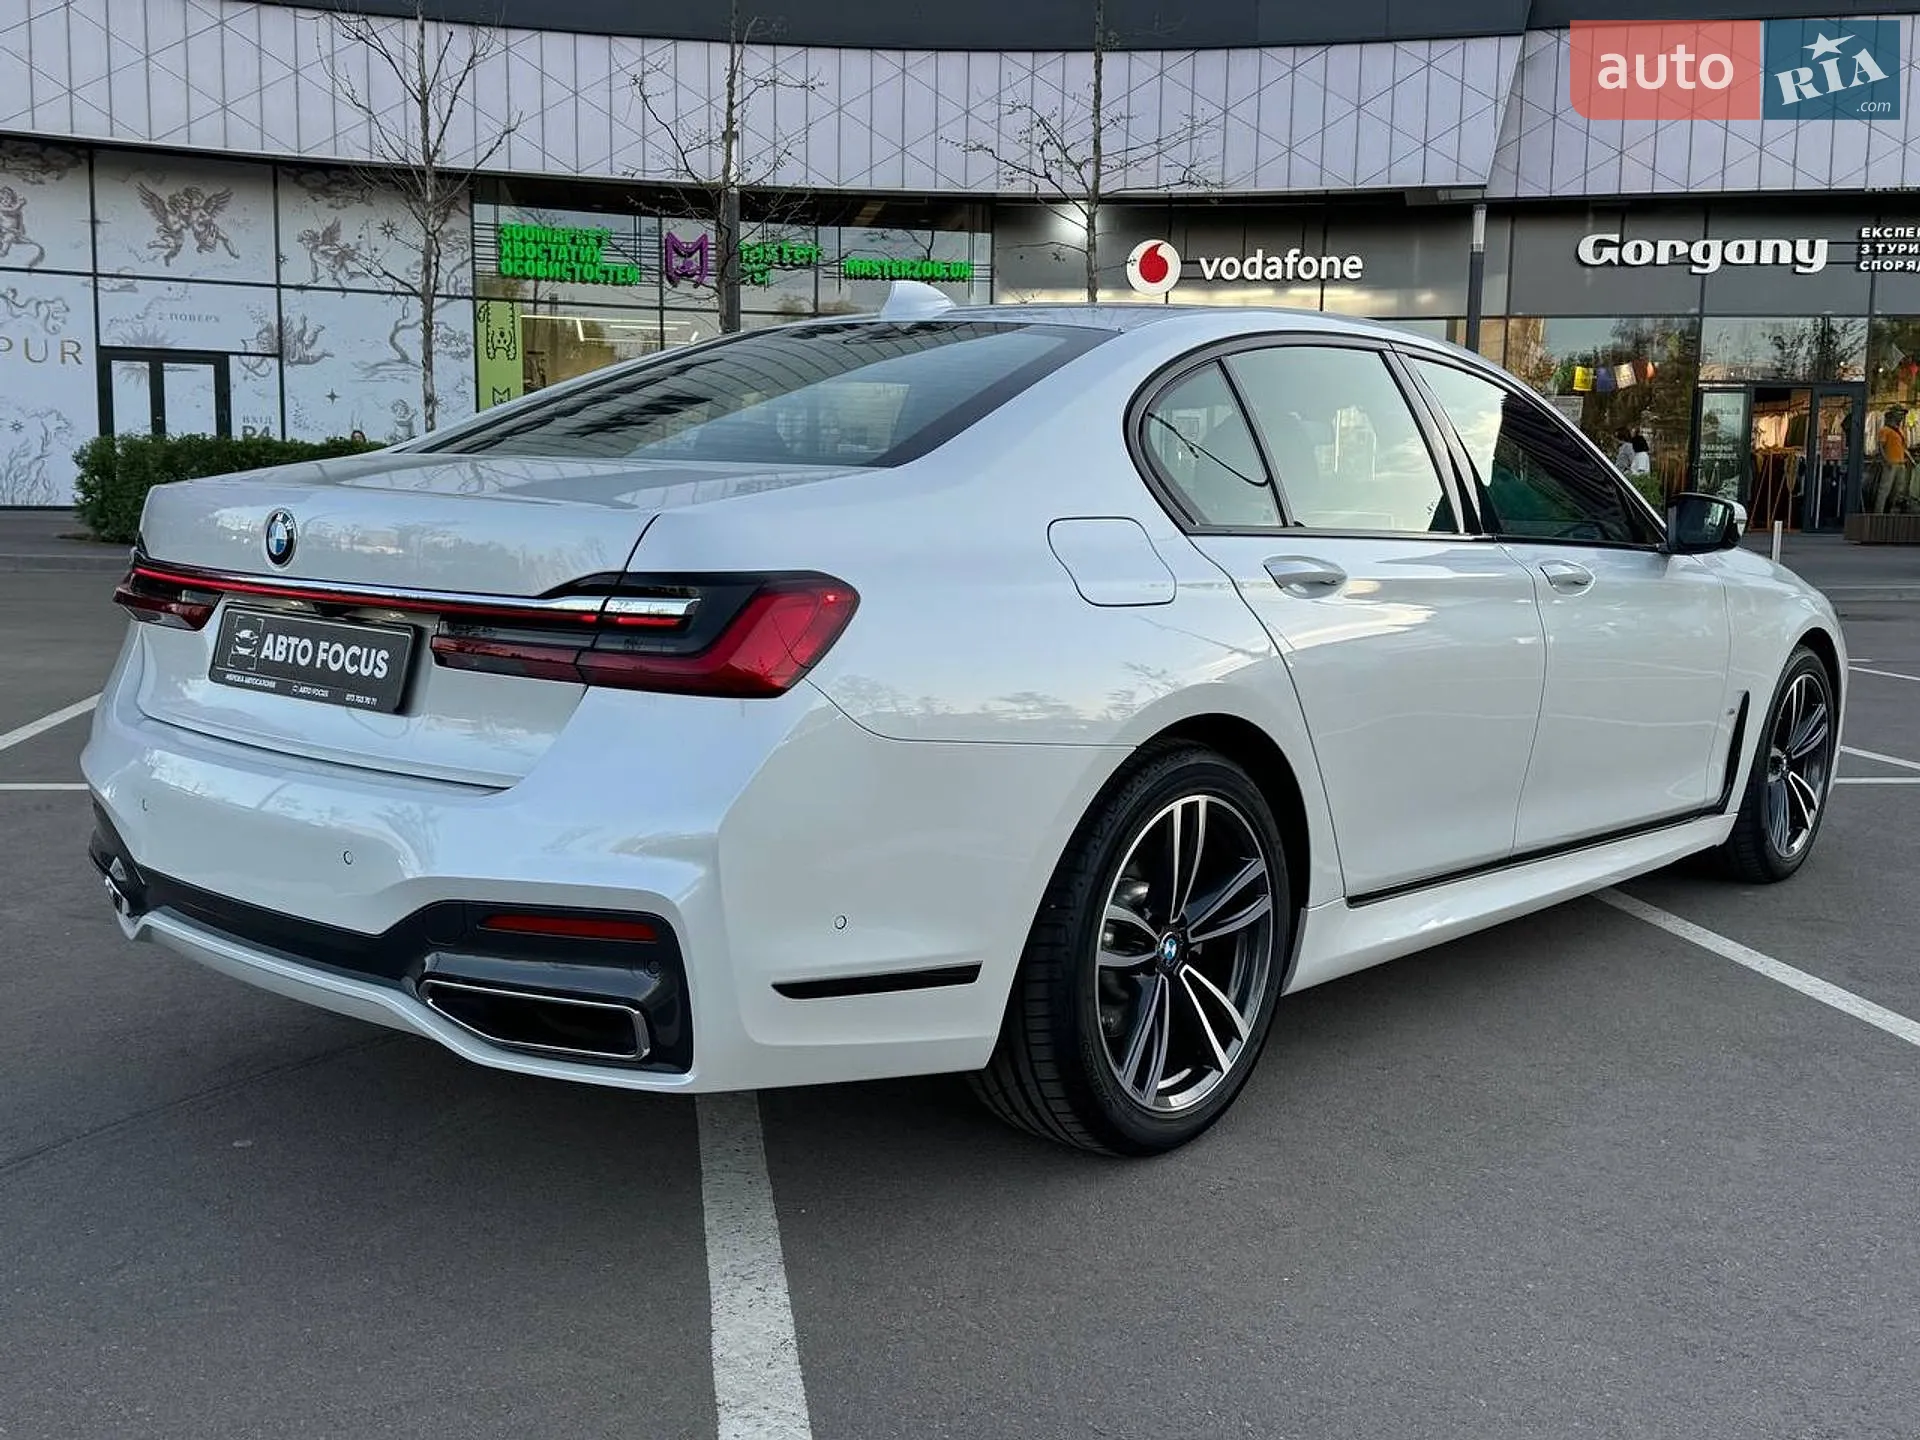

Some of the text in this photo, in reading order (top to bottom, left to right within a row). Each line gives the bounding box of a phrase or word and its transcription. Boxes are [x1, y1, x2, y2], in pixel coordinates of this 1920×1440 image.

[1200, 248, 1364, 281] vodafone
[1577, 234, 1828, 274] Gorgany
[260, 633, 390, 679] АВТО FOCUS
